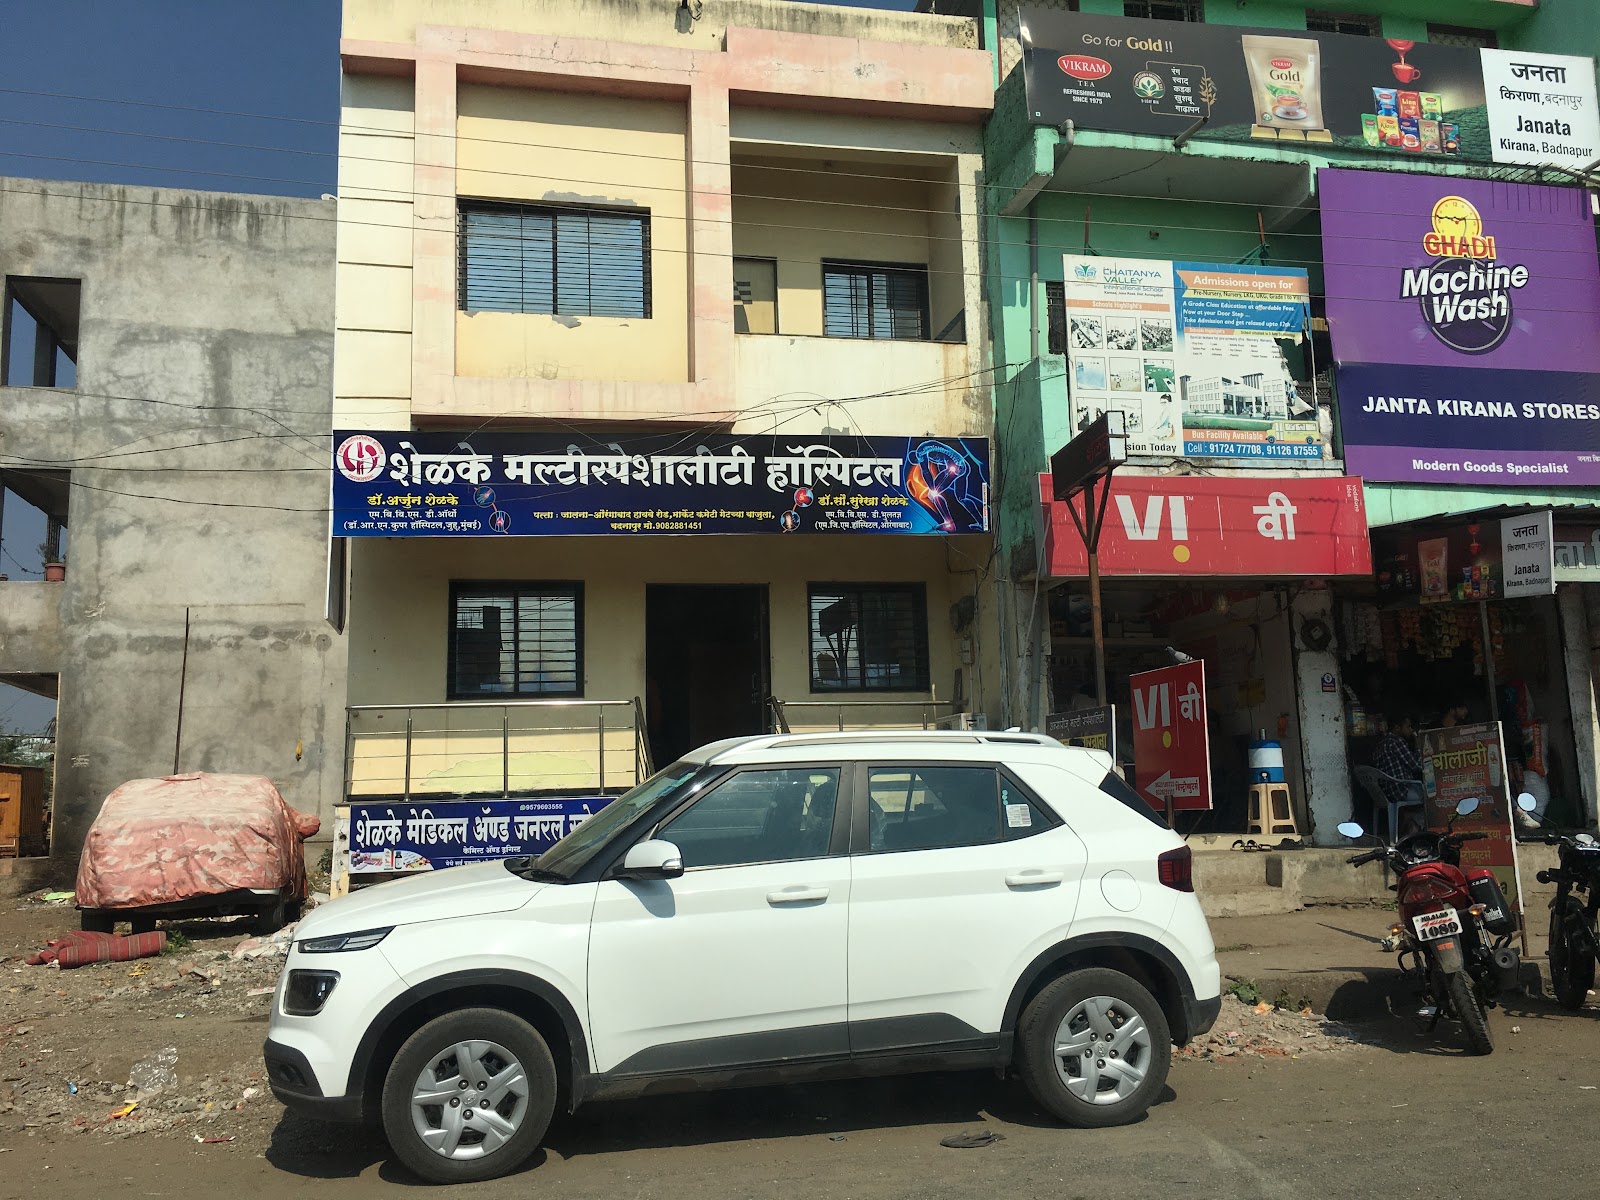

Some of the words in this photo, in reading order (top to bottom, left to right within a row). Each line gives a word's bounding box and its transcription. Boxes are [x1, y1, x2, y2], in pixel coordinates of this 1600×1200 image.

[1082, 33, 1102, 46] Go
[1104, 35, 1123, 47] for
[1126, 36, 1163, 52] Gold
[1062, 59, 1107, 74] VIKRAM
[1509, 62, 1566, 84] जनता
[1269, 69, 1300, 82] Gold
[1077, 80, 1096, 88] TEA
[1063, 88, 1096, 98] REFRESHING
[1097, 91, 1112, 99] INDIA
[1072, 95, 1088, 103] SINCE
[1089, 96, 1103, 104] 1975
[1516, 115, 1571, 136] Janata
[1500, 138, 1539, 154] Kirana,
[1542, 141, 1593, 158] Badnapur
[1425, 233, 1495, 258] GHADI
[1102, 266, 1162, 278] CHAITANYA
[1104, 276, 1143, 284] VALLEY
[1193, 275, 1249, 288] Admissions
[1251, 279, 1276, 290] open
[1278, 280, 1293, 290] for
[1402, 262, 1529, 298] Machine
[1092, 300, 1114, 309] Schools
[1115, 301, 1143, 310] Highlight's
[1432, 291, 1509, 325] Wash
[1363, 396, 1432, 415] JANTA
[1437, 400, 1518, 419] KIRANA
[1522, 403, 1600, 420] STORES
[1191, 430, 1204, 439] Bus
[1206, 431, 1231, 441] Facility
[1233, 432, 1264, 441] Available
[1150, 442, 1177, 454] Today
[1187, 442, 1203, 454] Cell
[1209, 443, 1235, 455] 91724
[1237, 444, 1264, 456] 77708,
[1266, 445, 1292, 456] 91126
[1294, 445, 1318, 457] 87555
[389, 440, 493, 487] शेळके
[764, 444, 903, 493] हॉस्पिटल
[1412, 459, 1460, 472] Modern
[1463, 460, 1504, 473] Goods
[1506, 461, 1569, 476] Specialist
[425, 492, 459, 505] शेळके
[880, 493, 909, 506] शेळके
[1352, 484, 1360, 512] vodafone
[1252, 491, 1298, 541] वी
[1512, 523, 1538, 538] जनता
[1514, 563, 1540, 576] Janata
[1525, 576, 1550, 587] Badnapur
[1177, 681, 1201, 722] वी
[1432, 740, 1488, 770] बालाजी
[355, 808, 403, 849] शेळके
[406, 808, 469, 846] मेडिकल
[513, 814, 566, 843] जनरल
[1419, 921, 1459, 940] 1089
